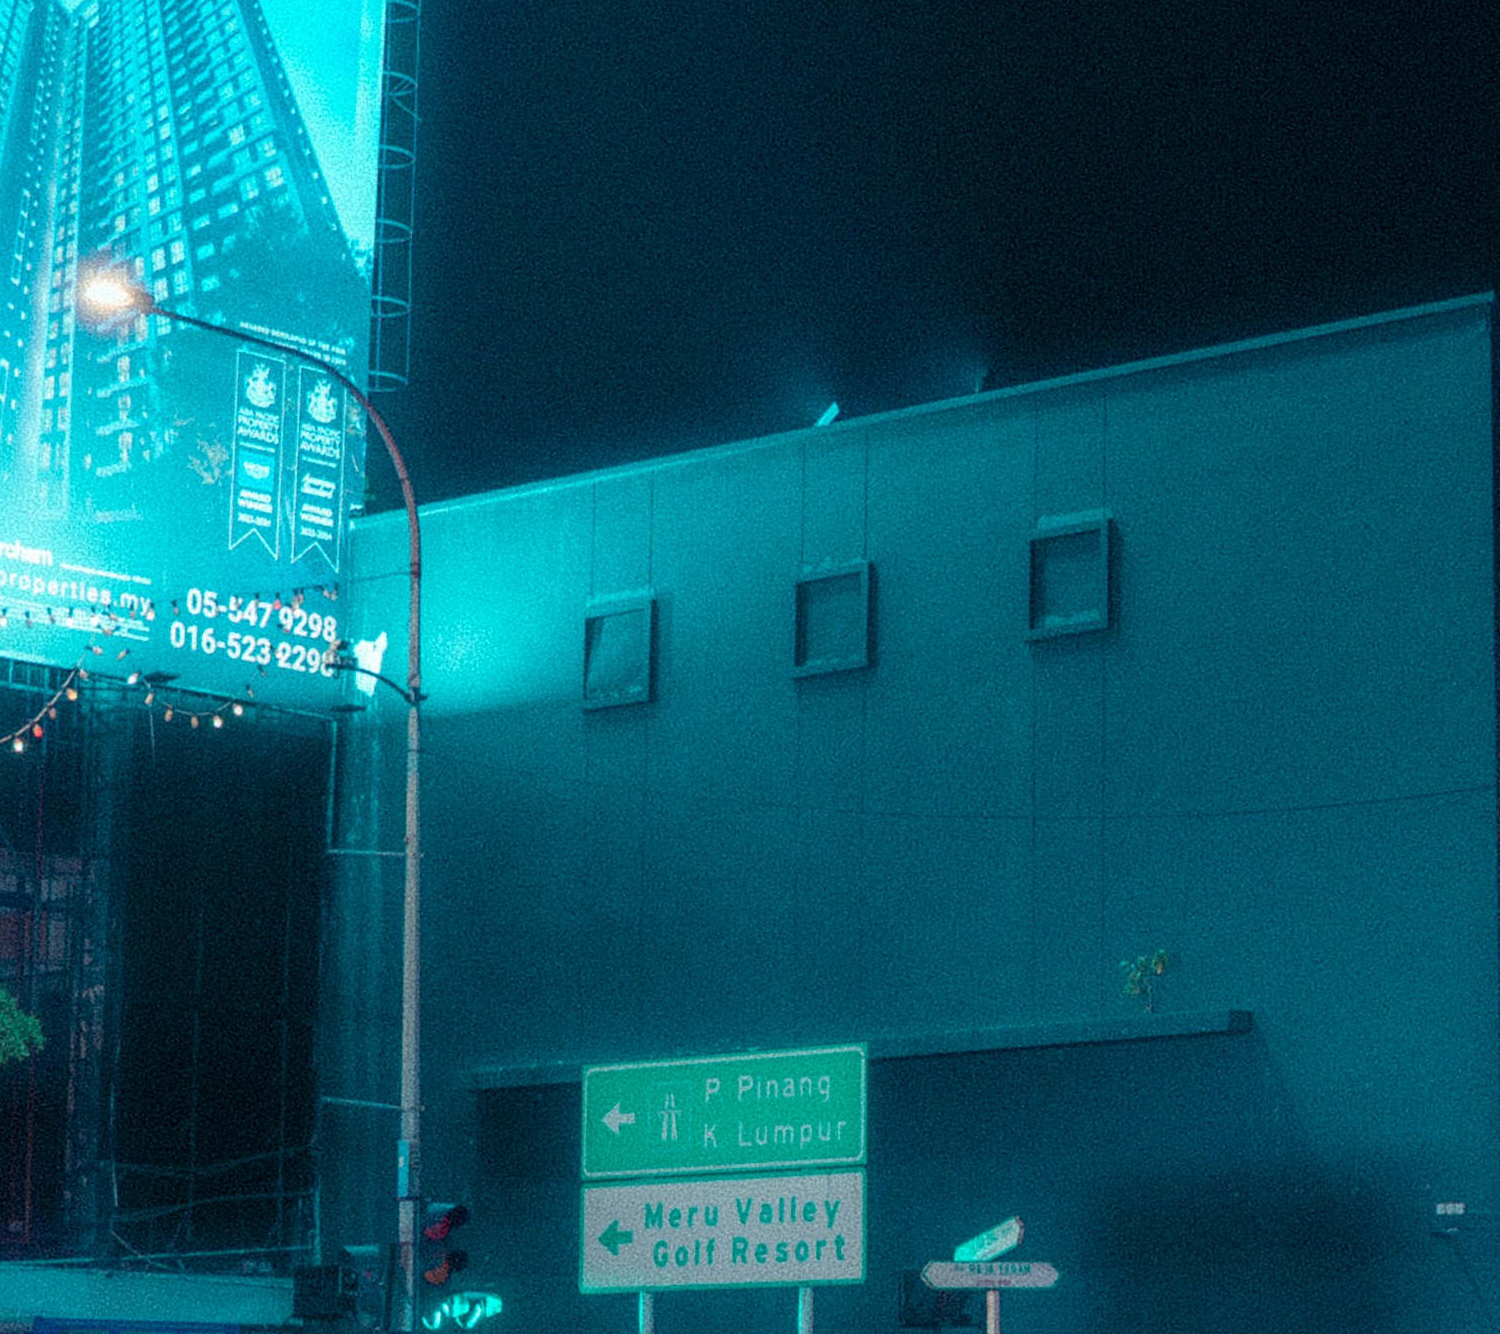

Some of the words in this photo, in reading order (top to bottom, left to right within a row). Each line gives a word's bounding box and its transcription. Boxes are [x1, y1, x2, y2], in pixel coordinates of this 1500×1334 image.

[187, 588, 273, 628] 05-547
[279, 605, 338, 642] 9298
[170, 621, 271, 665] 016-523
[704, 1077, 721, 1103] P
[738, 1071, 833, 1103] Pinang
[703, 1122, 719, 1148] K
[738, 1115, 849, 1150] Lumpur
[643, 1199, 719, 1230] Meru
[736, 1195, 842, 1229] Valley
[652, 1239, 716, 1268] Golf
[731, 1232, 846, 1265] Resort
